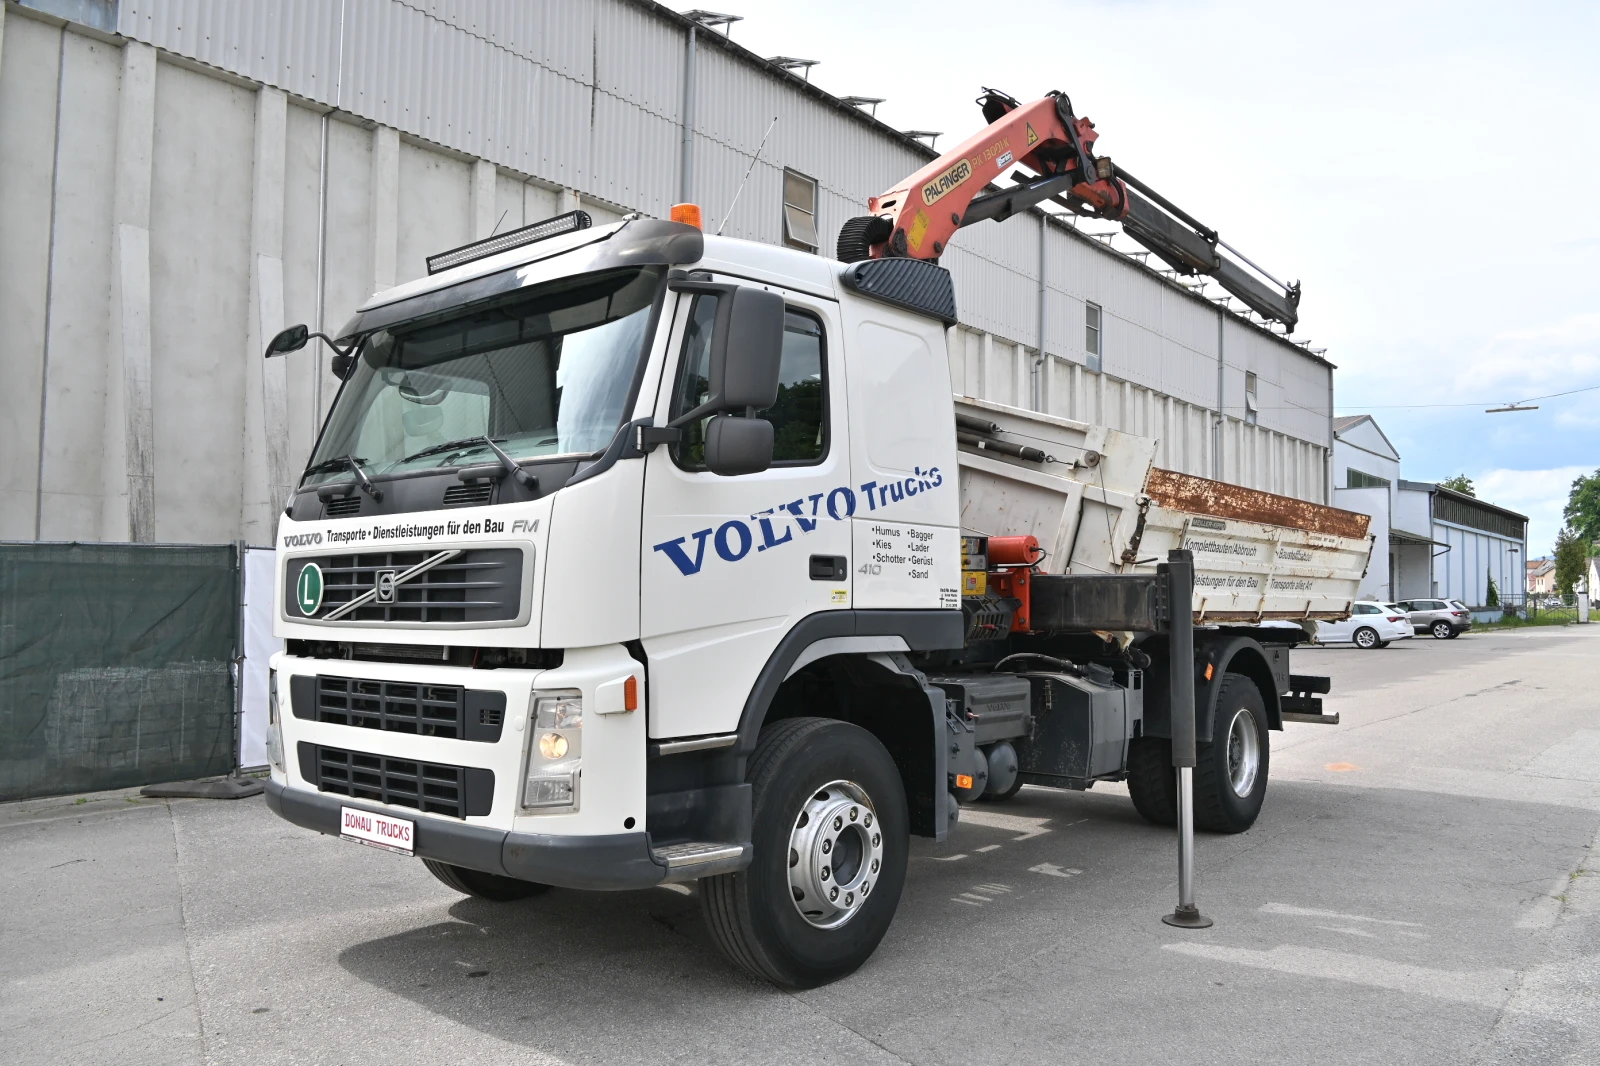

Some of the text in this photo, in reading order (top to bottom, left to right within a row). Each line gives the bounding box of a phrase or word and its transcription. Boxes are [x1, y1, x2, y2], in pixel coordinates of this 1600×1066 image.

[971, 153, 984, 170] PK
[924, 162, 970, 203] PALFINGER
[511, 519, 540, 534] FM
[653, 466, 943, 577] VOLVO Trucks
[327, 518, 505, 544] Transporte Dienstleistungen für den Bau
[875, 525, 900, 537] Humus
[910, 529, 933, 541] Bagger
[283, 532, 323, 547] VOLVO
[875, 539, 892, 550] Kies
[911, 542, 929, 552] Lader
[876, 552, 906, 564] Schotter
[911, 555, 933, 566] Gerüst
[858, 563, 881, 575] 410
[911, 569, 929, 579] Sand
[1235, 576, 1247, 588] den
[1246, 576, 1259, 588] Bau
[1270, 578, 1295, 591] Transporte
[303, 573, 314, 604] L
[345, 813, 410, 841] DONAU TRUCKS
